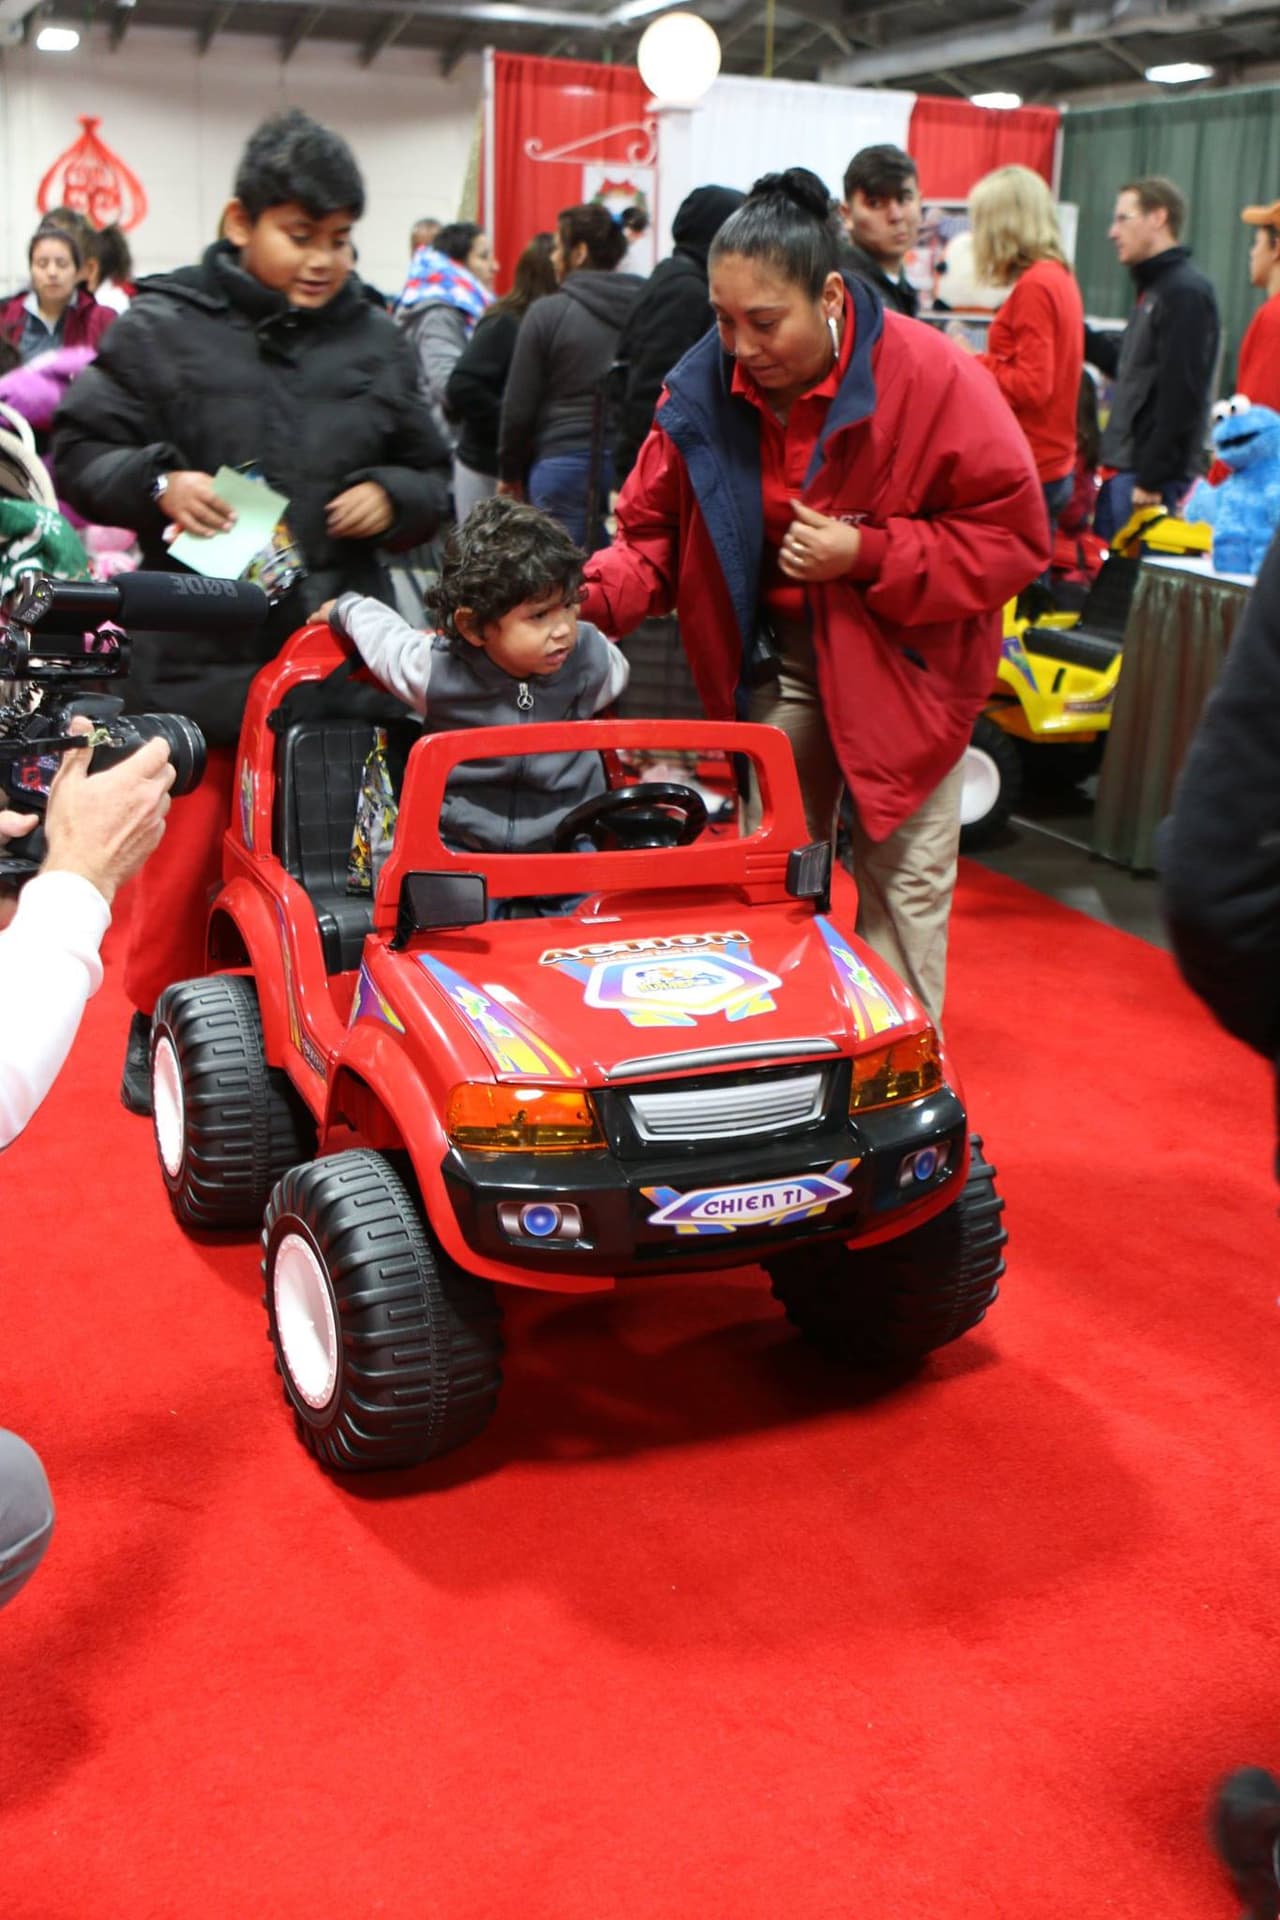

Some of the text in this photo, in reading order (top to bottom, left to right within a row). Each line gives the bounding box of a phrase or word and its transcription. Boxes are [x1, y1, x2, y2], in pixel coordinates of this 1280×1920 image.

[539, 931, 751, 965] ACTION
[703, 1189, 802, 1216] CHIEN TI
